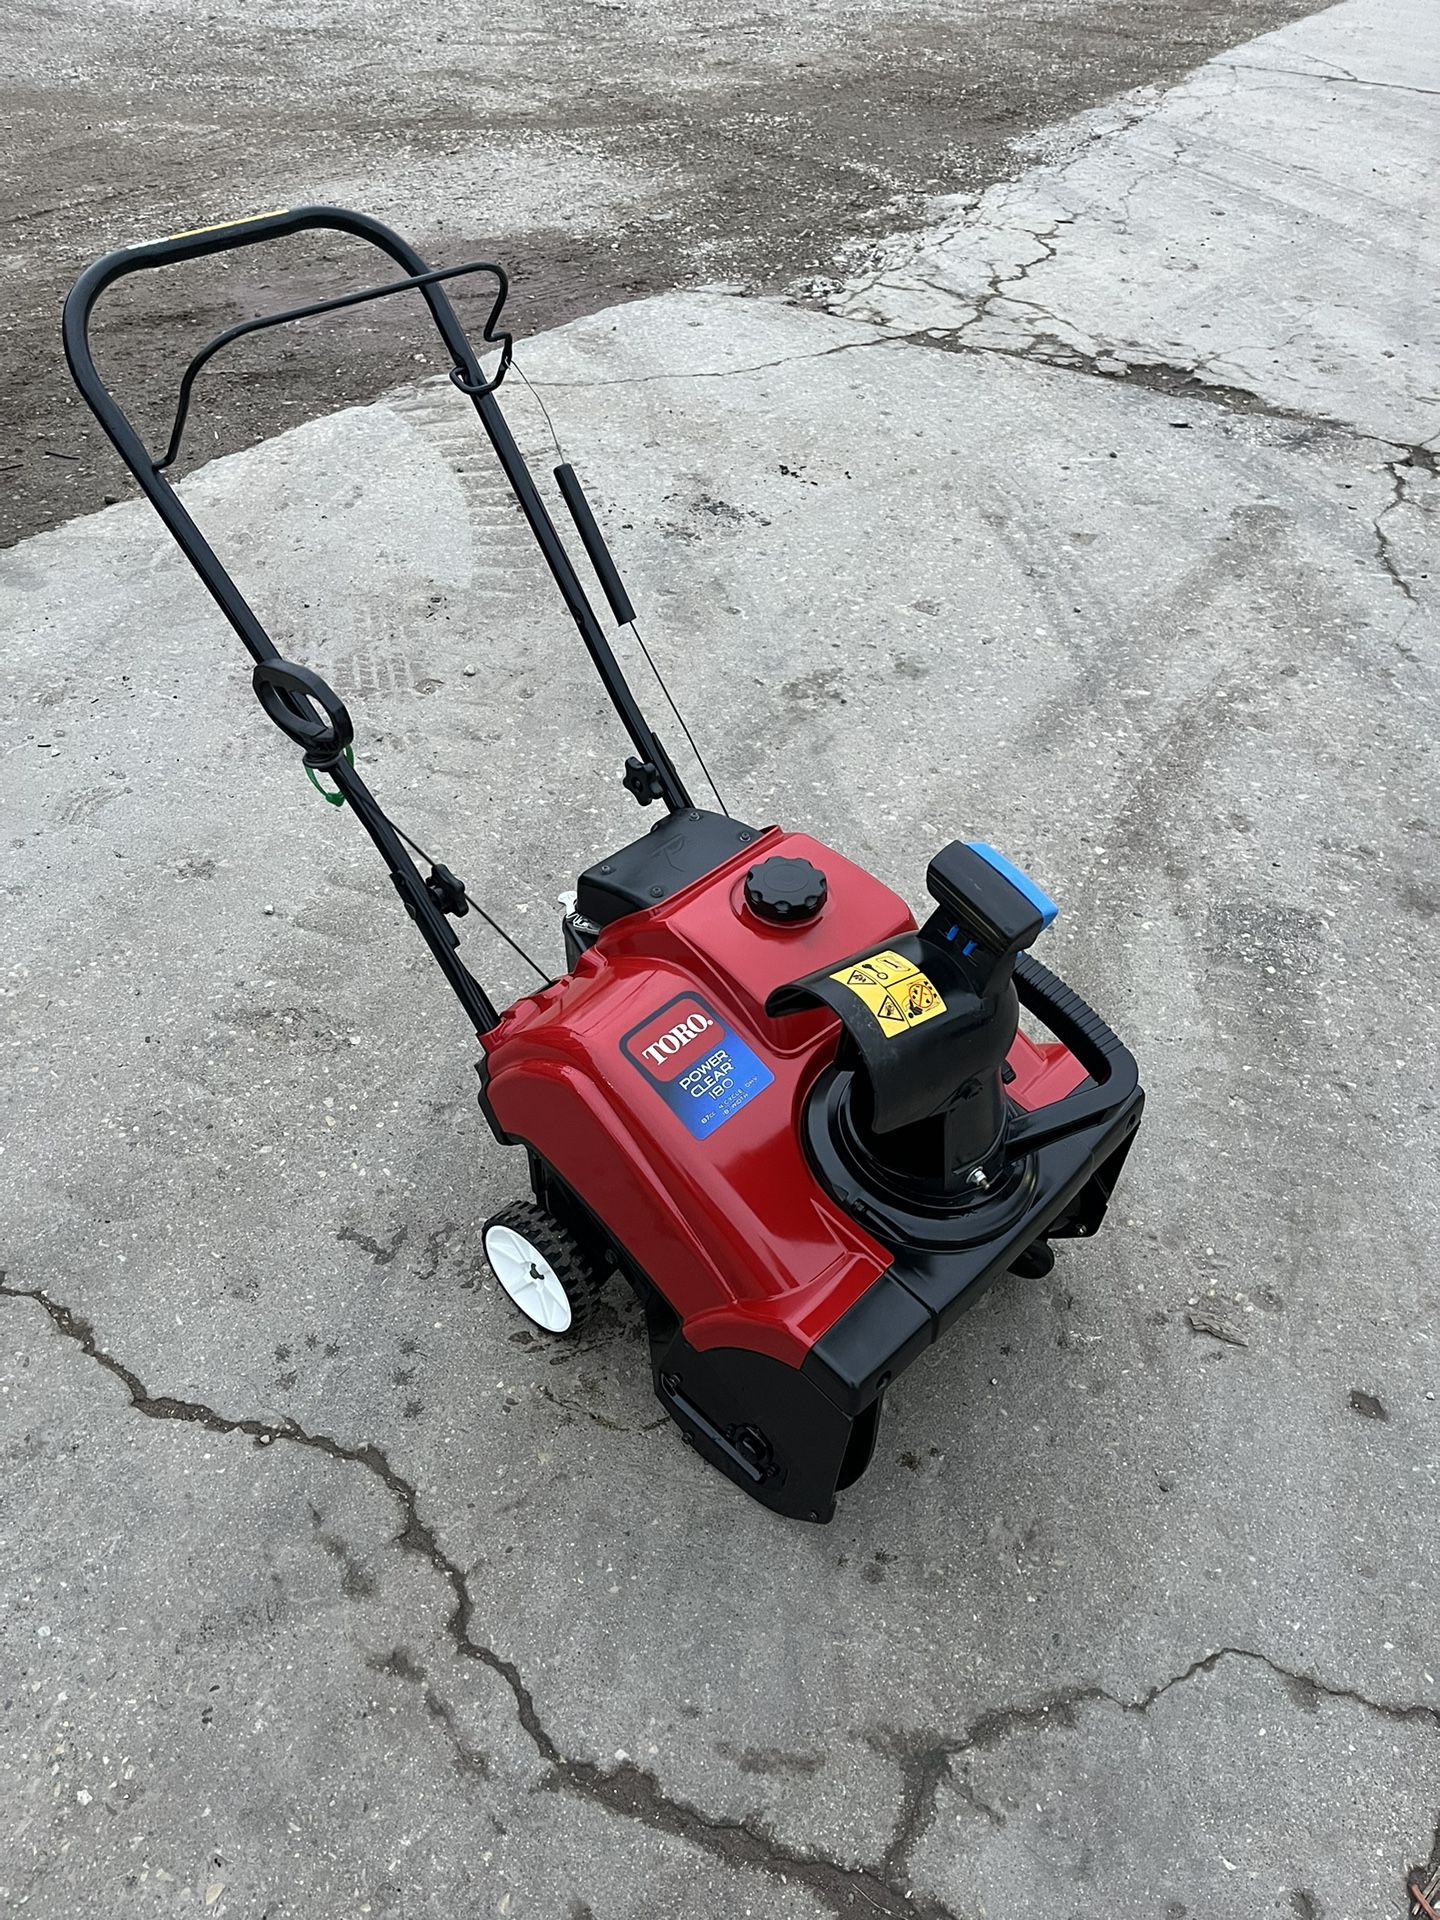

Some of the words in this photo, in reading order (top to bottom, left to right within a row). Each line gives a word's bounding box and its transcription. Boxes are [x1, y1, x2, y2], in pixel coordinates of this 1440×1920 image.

[679, 1049, 728, 1091] POWER
[690, 1061, 734, 1098] CLEAR
[708, 1078, 734, 1100] 180
